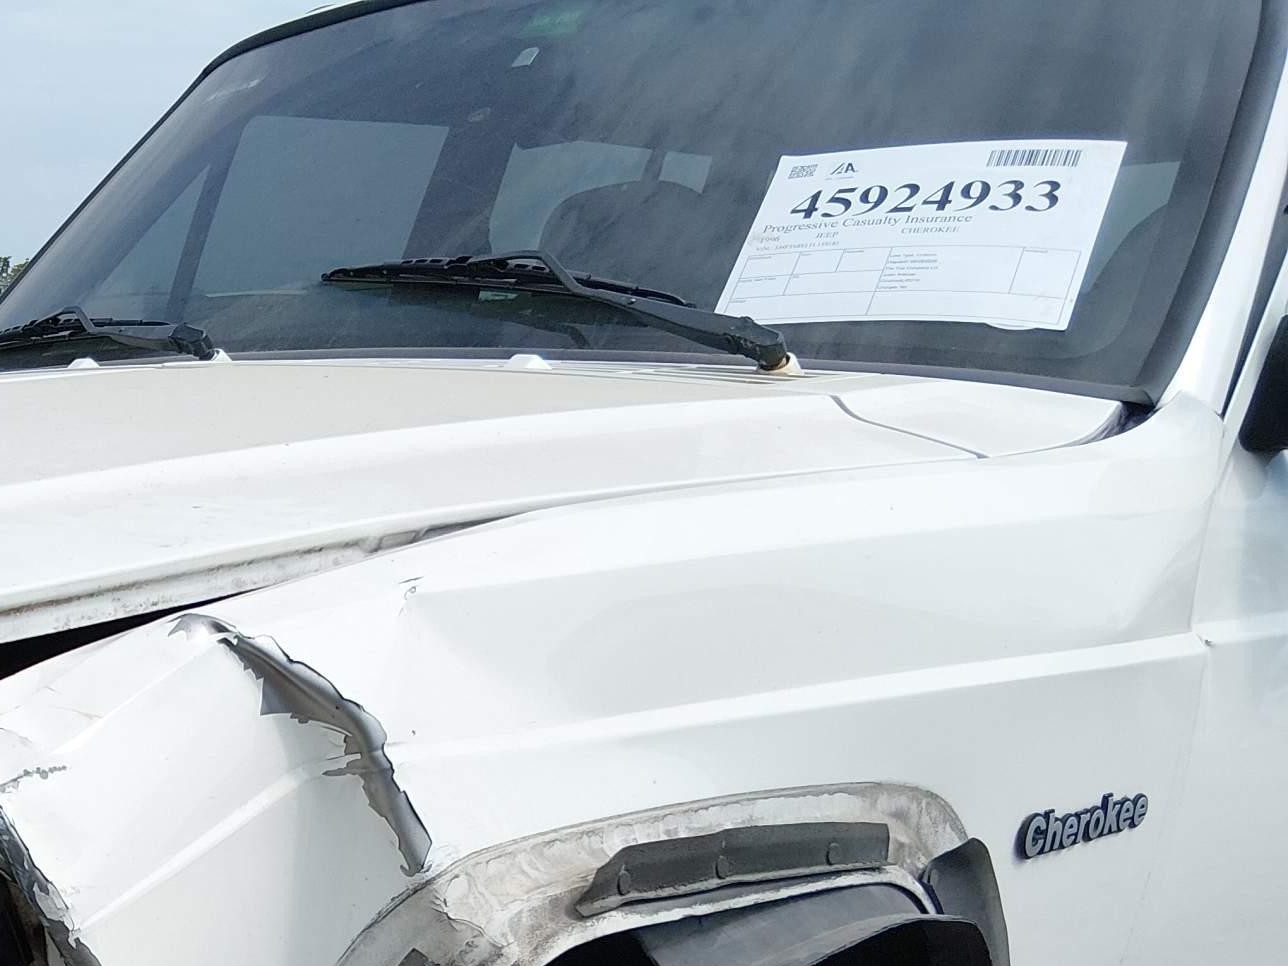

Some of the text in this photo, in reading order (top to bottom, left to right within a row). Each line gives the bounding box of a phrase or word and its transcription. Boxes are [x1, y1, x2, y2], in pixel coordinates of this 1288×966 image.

[789, 180, 1062, 219] 45924933
[762, 213, 973, 235] Progressive Casualty Insurance
[900, 225, 960, 234] CHEROKEE
[1014, 792, 1148, 860] Cherokee
